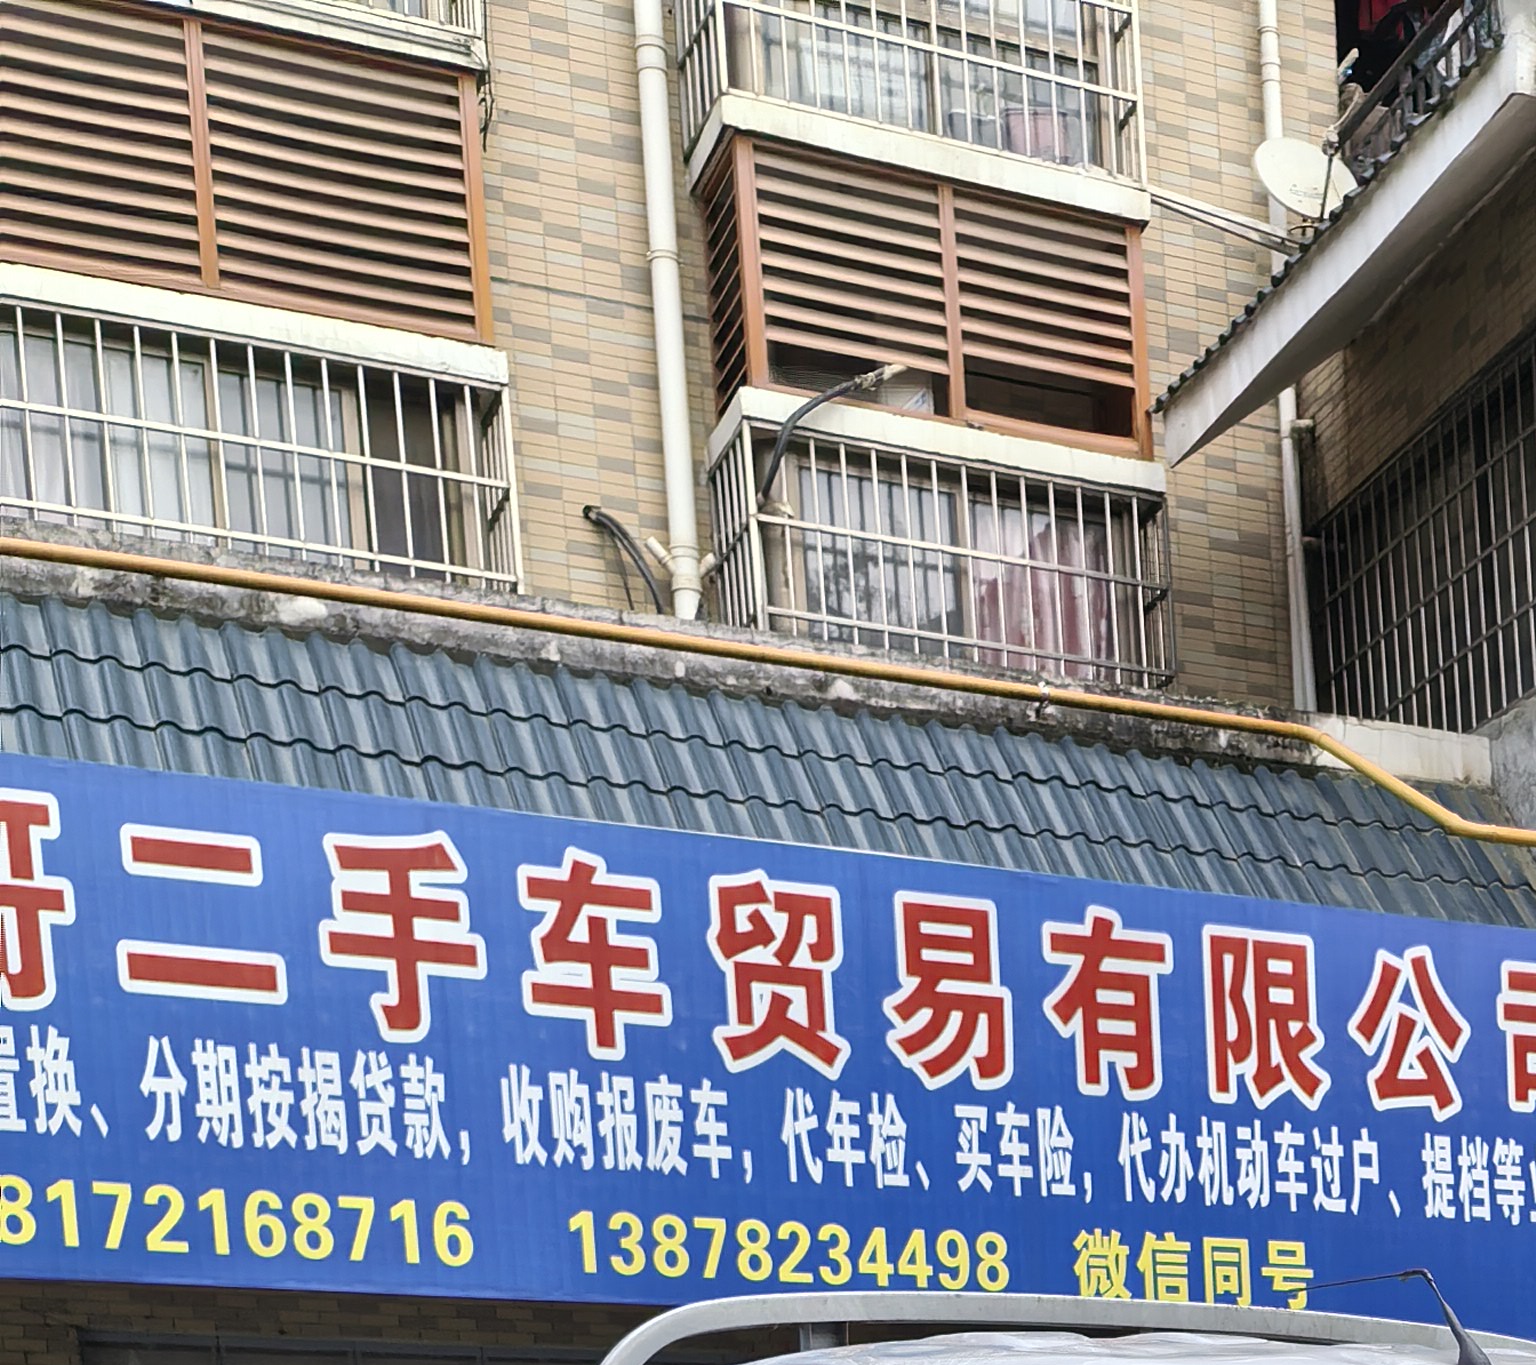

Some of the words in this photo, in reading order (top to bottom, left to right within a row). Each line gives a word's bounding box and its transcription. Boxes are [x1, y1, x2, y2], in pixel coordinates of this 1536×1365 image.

[568, 1209, 1010, 1292] 13878234498
[1072, 1227, 1315, 1311] 微信同号
